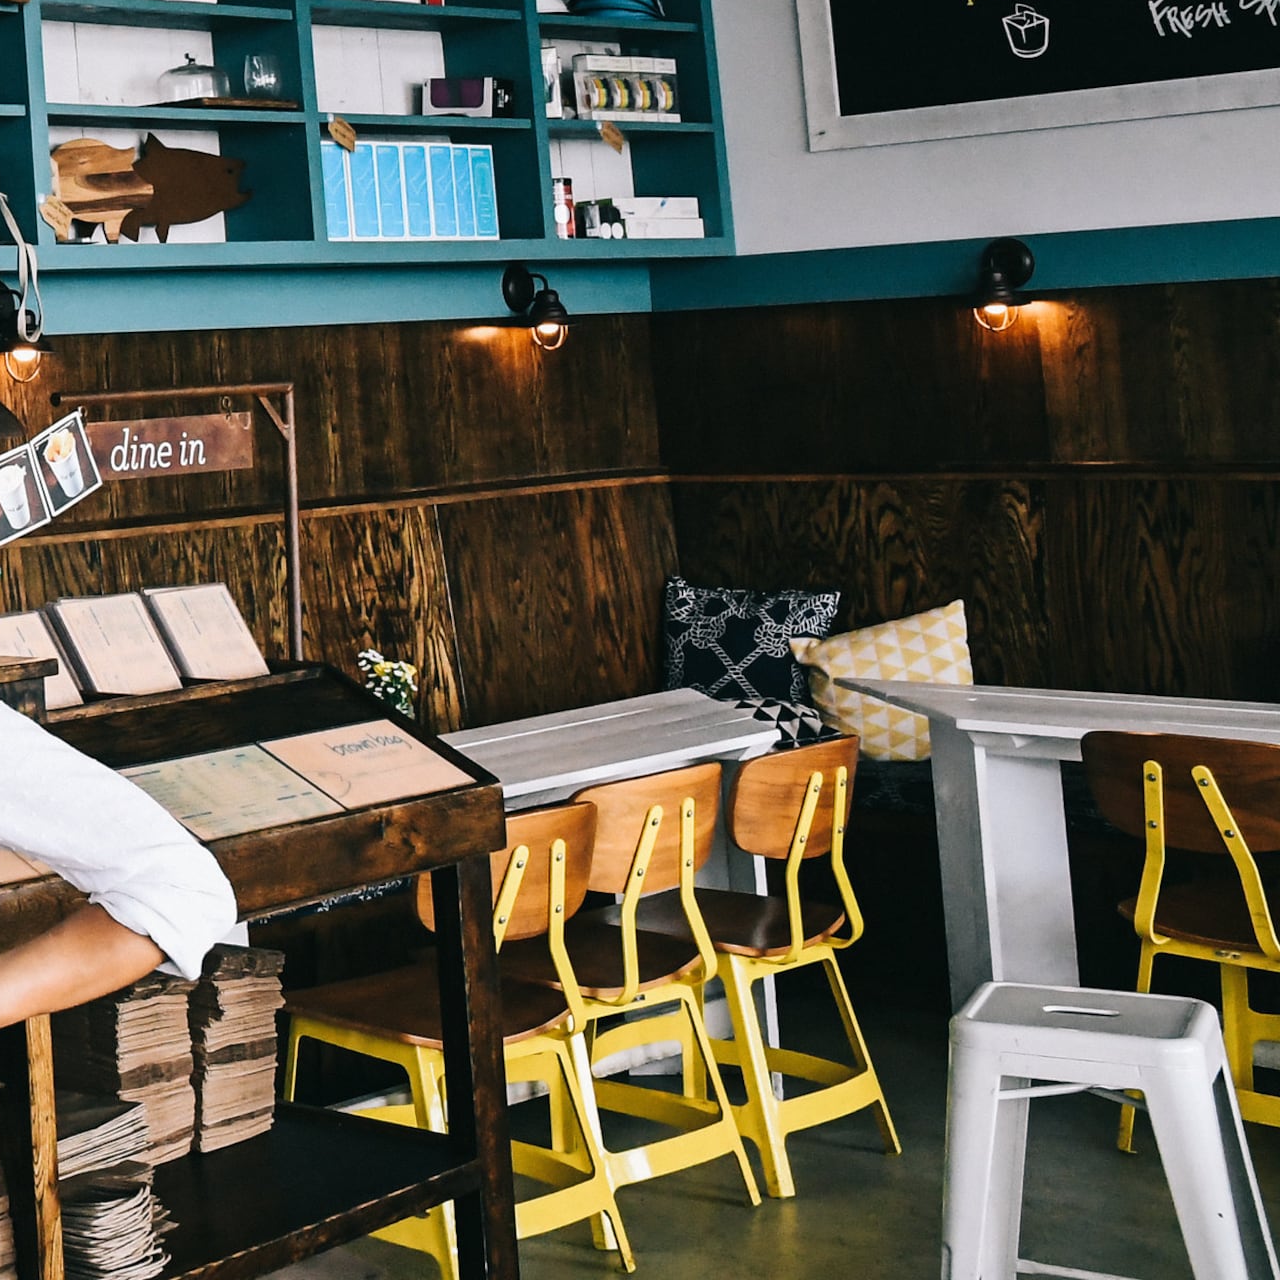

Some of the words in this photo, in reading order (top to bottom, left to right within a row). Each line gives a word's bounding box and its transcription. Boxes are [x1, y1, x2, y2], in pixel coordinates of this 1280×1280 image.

[110, 428, 173, 472] dine
[180, 431, 206, 467] in
[324, 737, 374, 757] brown
[367, 733, 413, 751] bag
